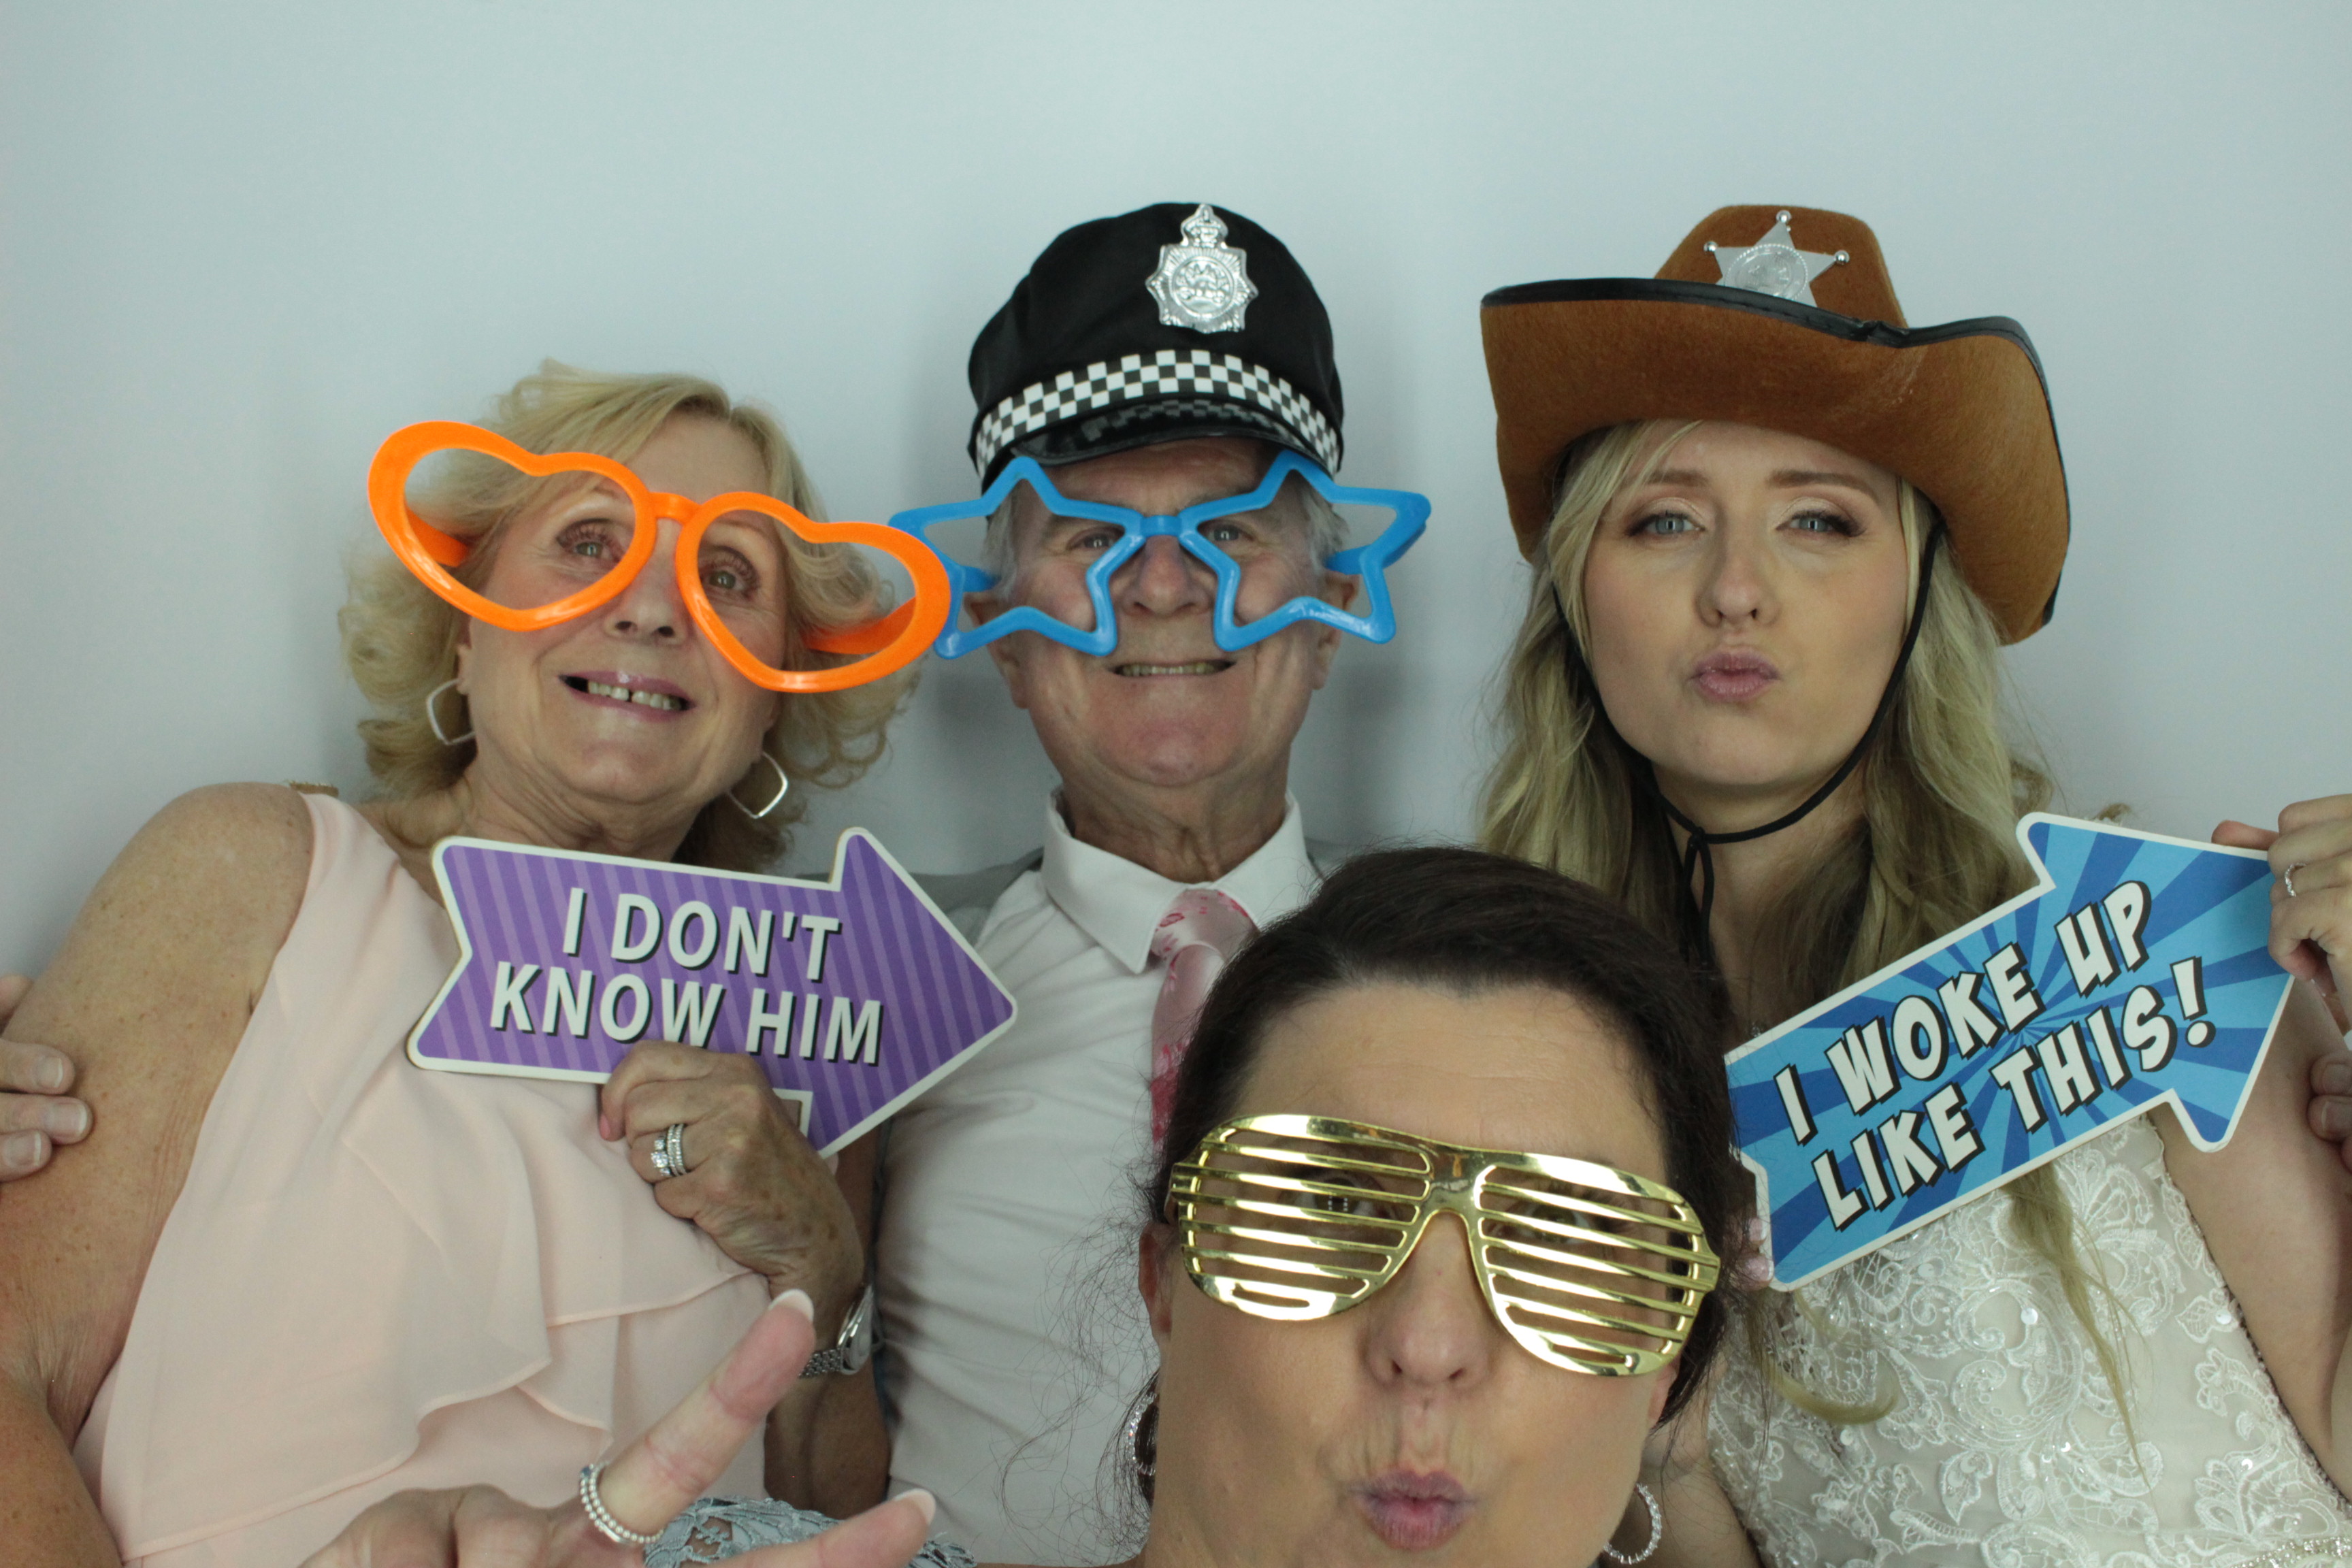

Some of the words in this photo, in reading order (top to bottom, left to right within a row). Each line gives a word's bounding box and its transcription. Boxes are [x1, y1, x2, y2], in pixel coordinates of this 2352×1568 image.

[489, 960, 725, 1049] KNOW
[746, 987, 883, 1066] HIM
[563, 887, 587, 956] I
[611, 892, 841, 982] DON'T
[1774, 1064, 1818, 1145] I
[1825, 941, 2046, 1116] WOKE
[2054, 880, 2152, 998] UP
[1811, 1081, 1986, 1231] LIKE
[1989, 956, 2217, 1134] THIS!
